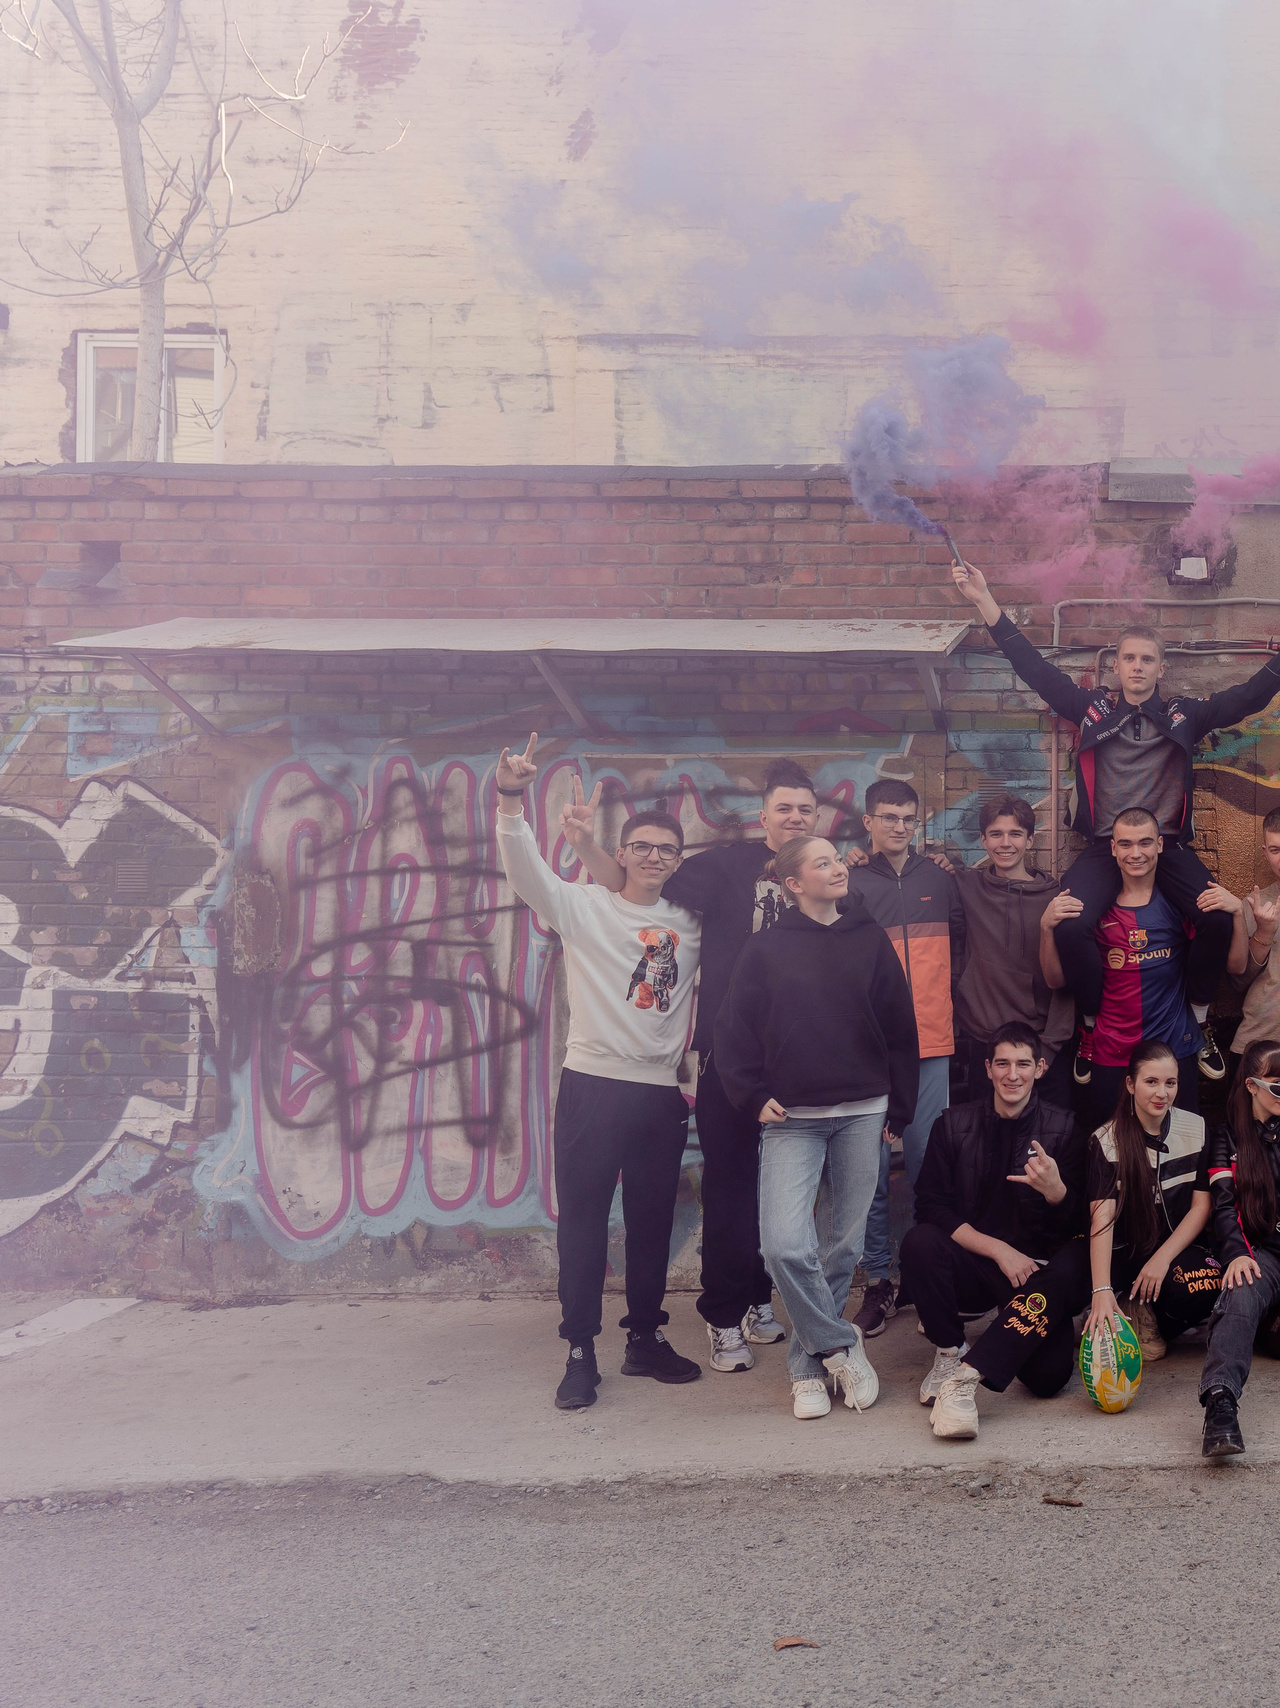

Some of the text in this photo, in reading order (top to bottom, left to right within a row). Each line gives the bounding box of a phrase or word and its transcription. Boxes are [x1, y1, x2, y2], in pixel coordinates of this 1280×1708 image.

[1127, 947, 1172, 963] Spotify
[1184, 1268, 1220, 1282] MINDSE
[1188, 1278, 1222, 1293] EVERYT
